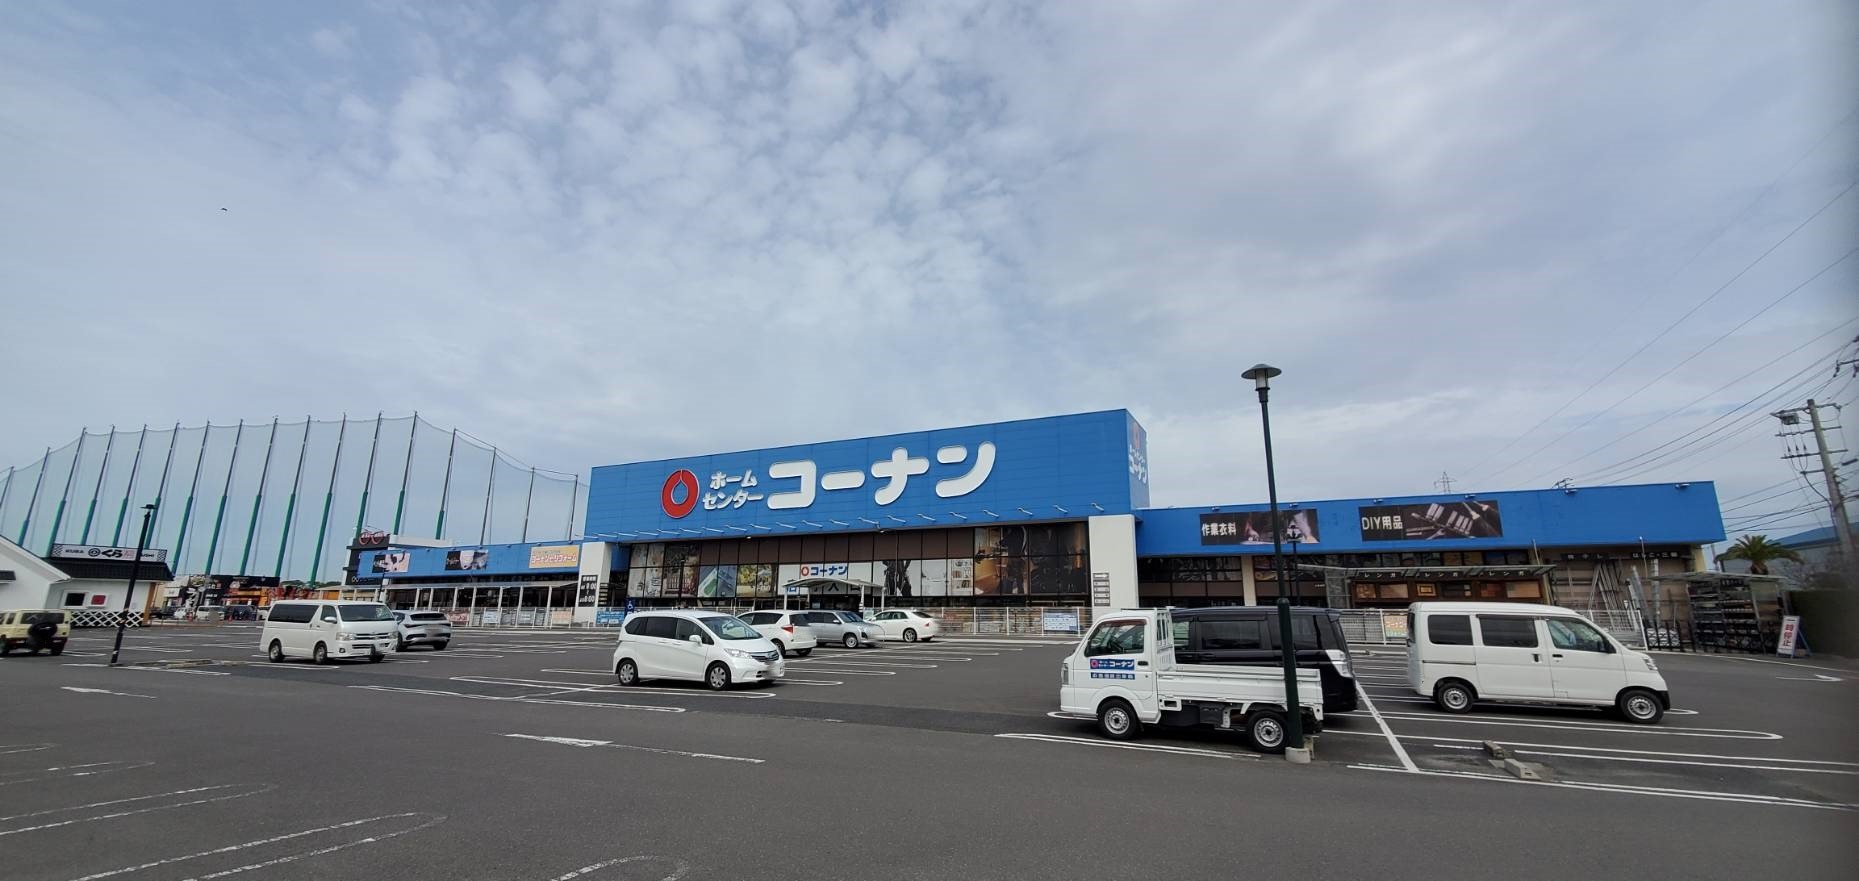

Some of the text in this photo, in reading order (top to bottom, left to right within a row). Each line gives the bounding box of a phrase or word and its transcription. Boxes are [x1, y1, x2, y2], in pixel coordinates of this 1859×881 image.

[709, 469, 758, 490] ホーム
[767, 440, 996, 510] コーナン
[702, 488, 764, 510] センター
[1202, 522, 1237, 536] 作業衣料
[1361, 515, 1403, 530] DIY用品
[810, 565, 848, 576] コーナン
